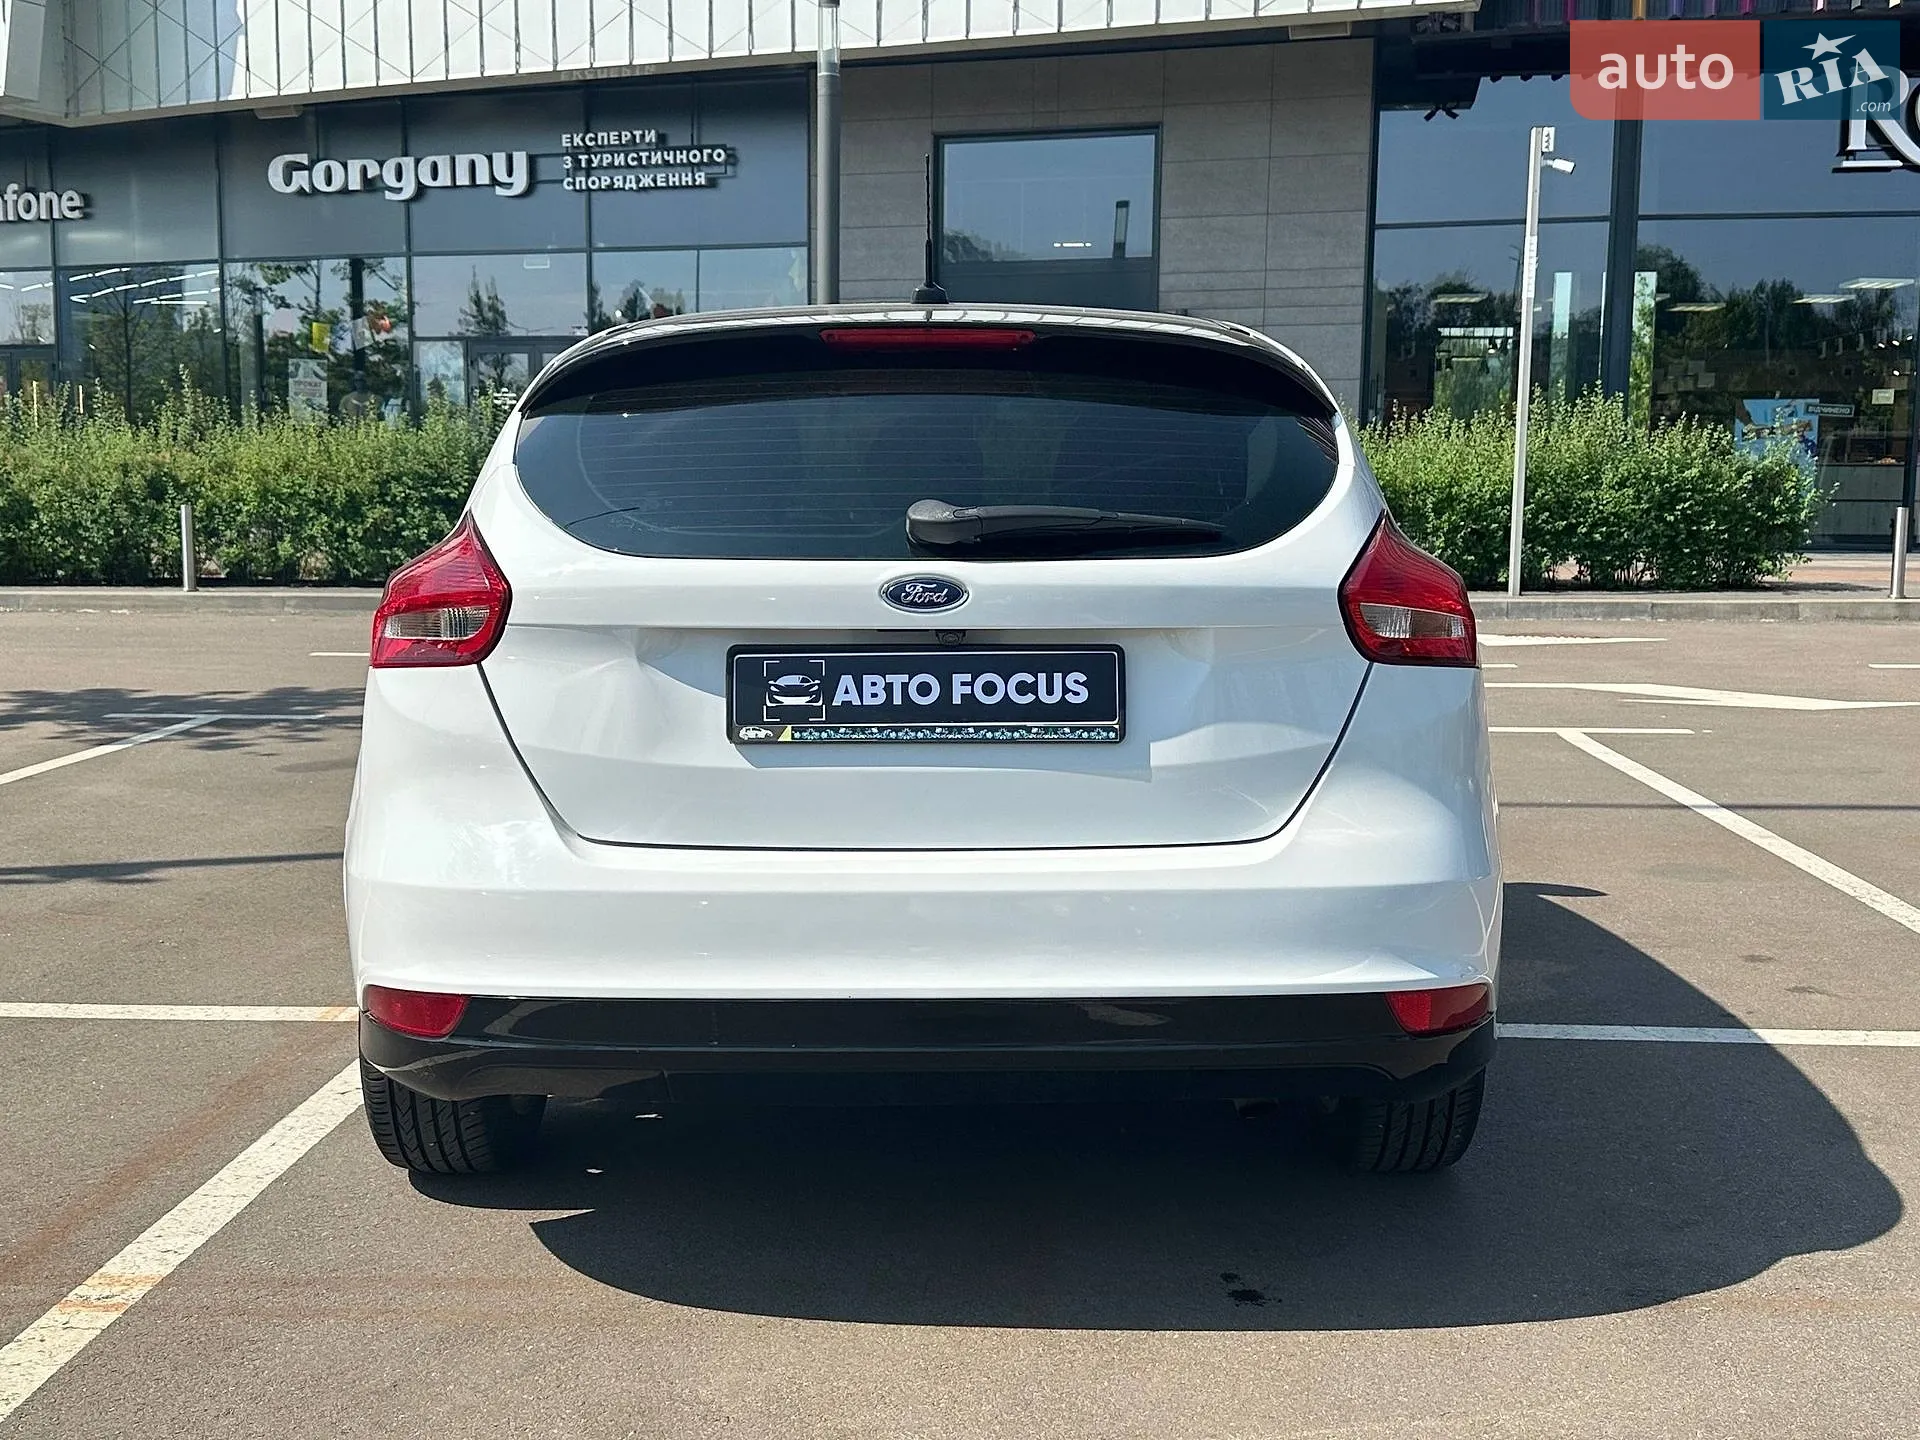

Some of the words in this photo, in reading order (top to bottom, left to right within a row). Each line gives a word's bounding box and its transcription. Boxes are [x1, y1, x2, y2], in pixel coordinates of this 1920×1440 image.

[561, 130, 656, 147] ЕКСПЕРТИ
[578, 149, 726, 168] ТУРИСТИЧНОГО
[267, 151, 528, 201] Gorgany
[563, 172, 706, 190] СПОРЯДЖЕННЯ
[0, 183, 84, 220] fone
[901, 583, 948, 603] Ford
[952, 671, 1089, 705] FOCUS
